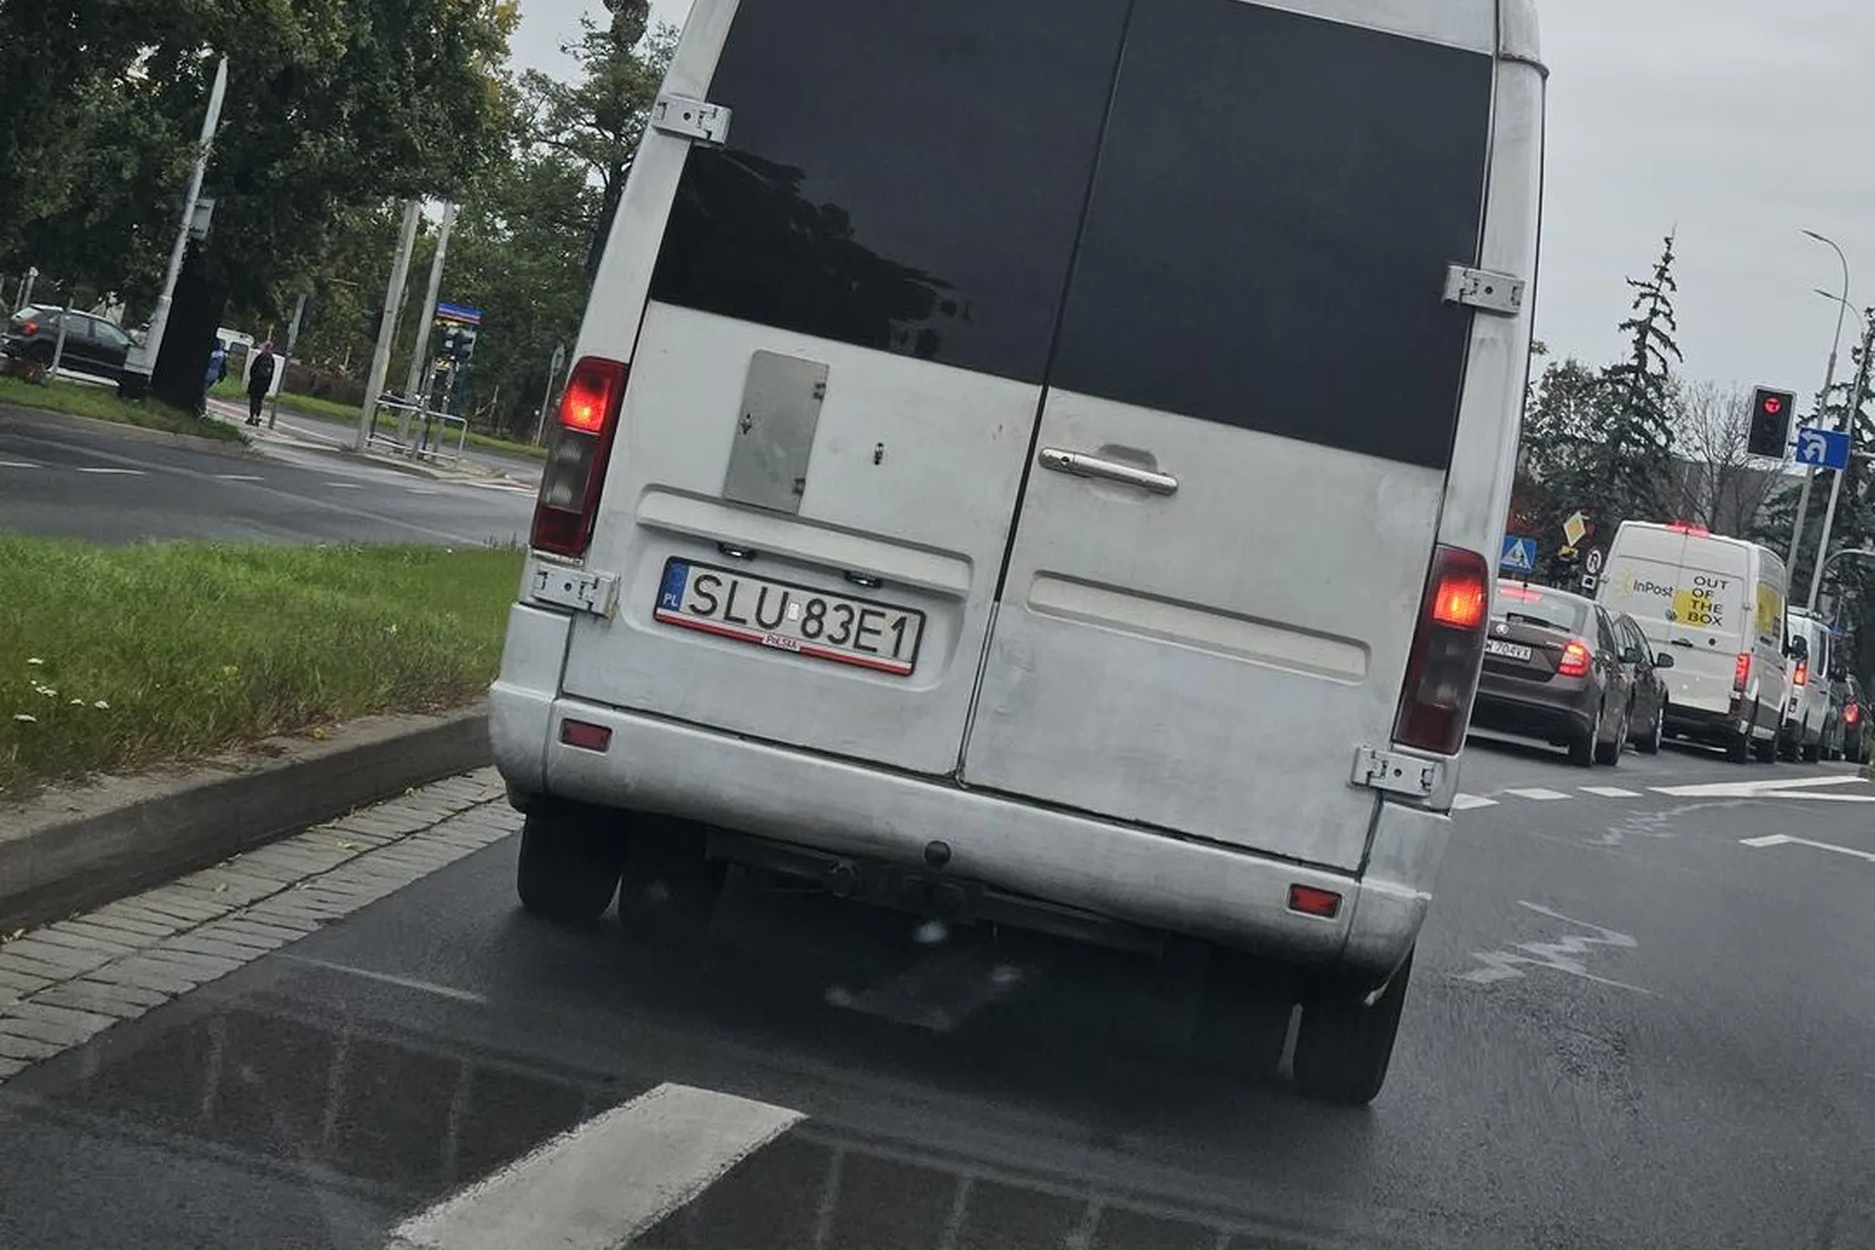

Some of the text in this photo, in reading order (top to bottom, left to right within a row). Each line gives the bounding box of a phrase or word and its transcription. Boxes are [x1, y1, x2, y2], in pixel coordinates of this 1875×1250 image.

[1633, 579, 1674, 598] InPost
[1693, 575, 1730, 590] OUT
[663, 593, 679, 607] PL
[1691, 587, 1715, 599] OF
[1689, 599, 1724, 615] THE
[688, 574, 908, 658] SLU 83E1
[1687, 611, 1724, 627] BOX
